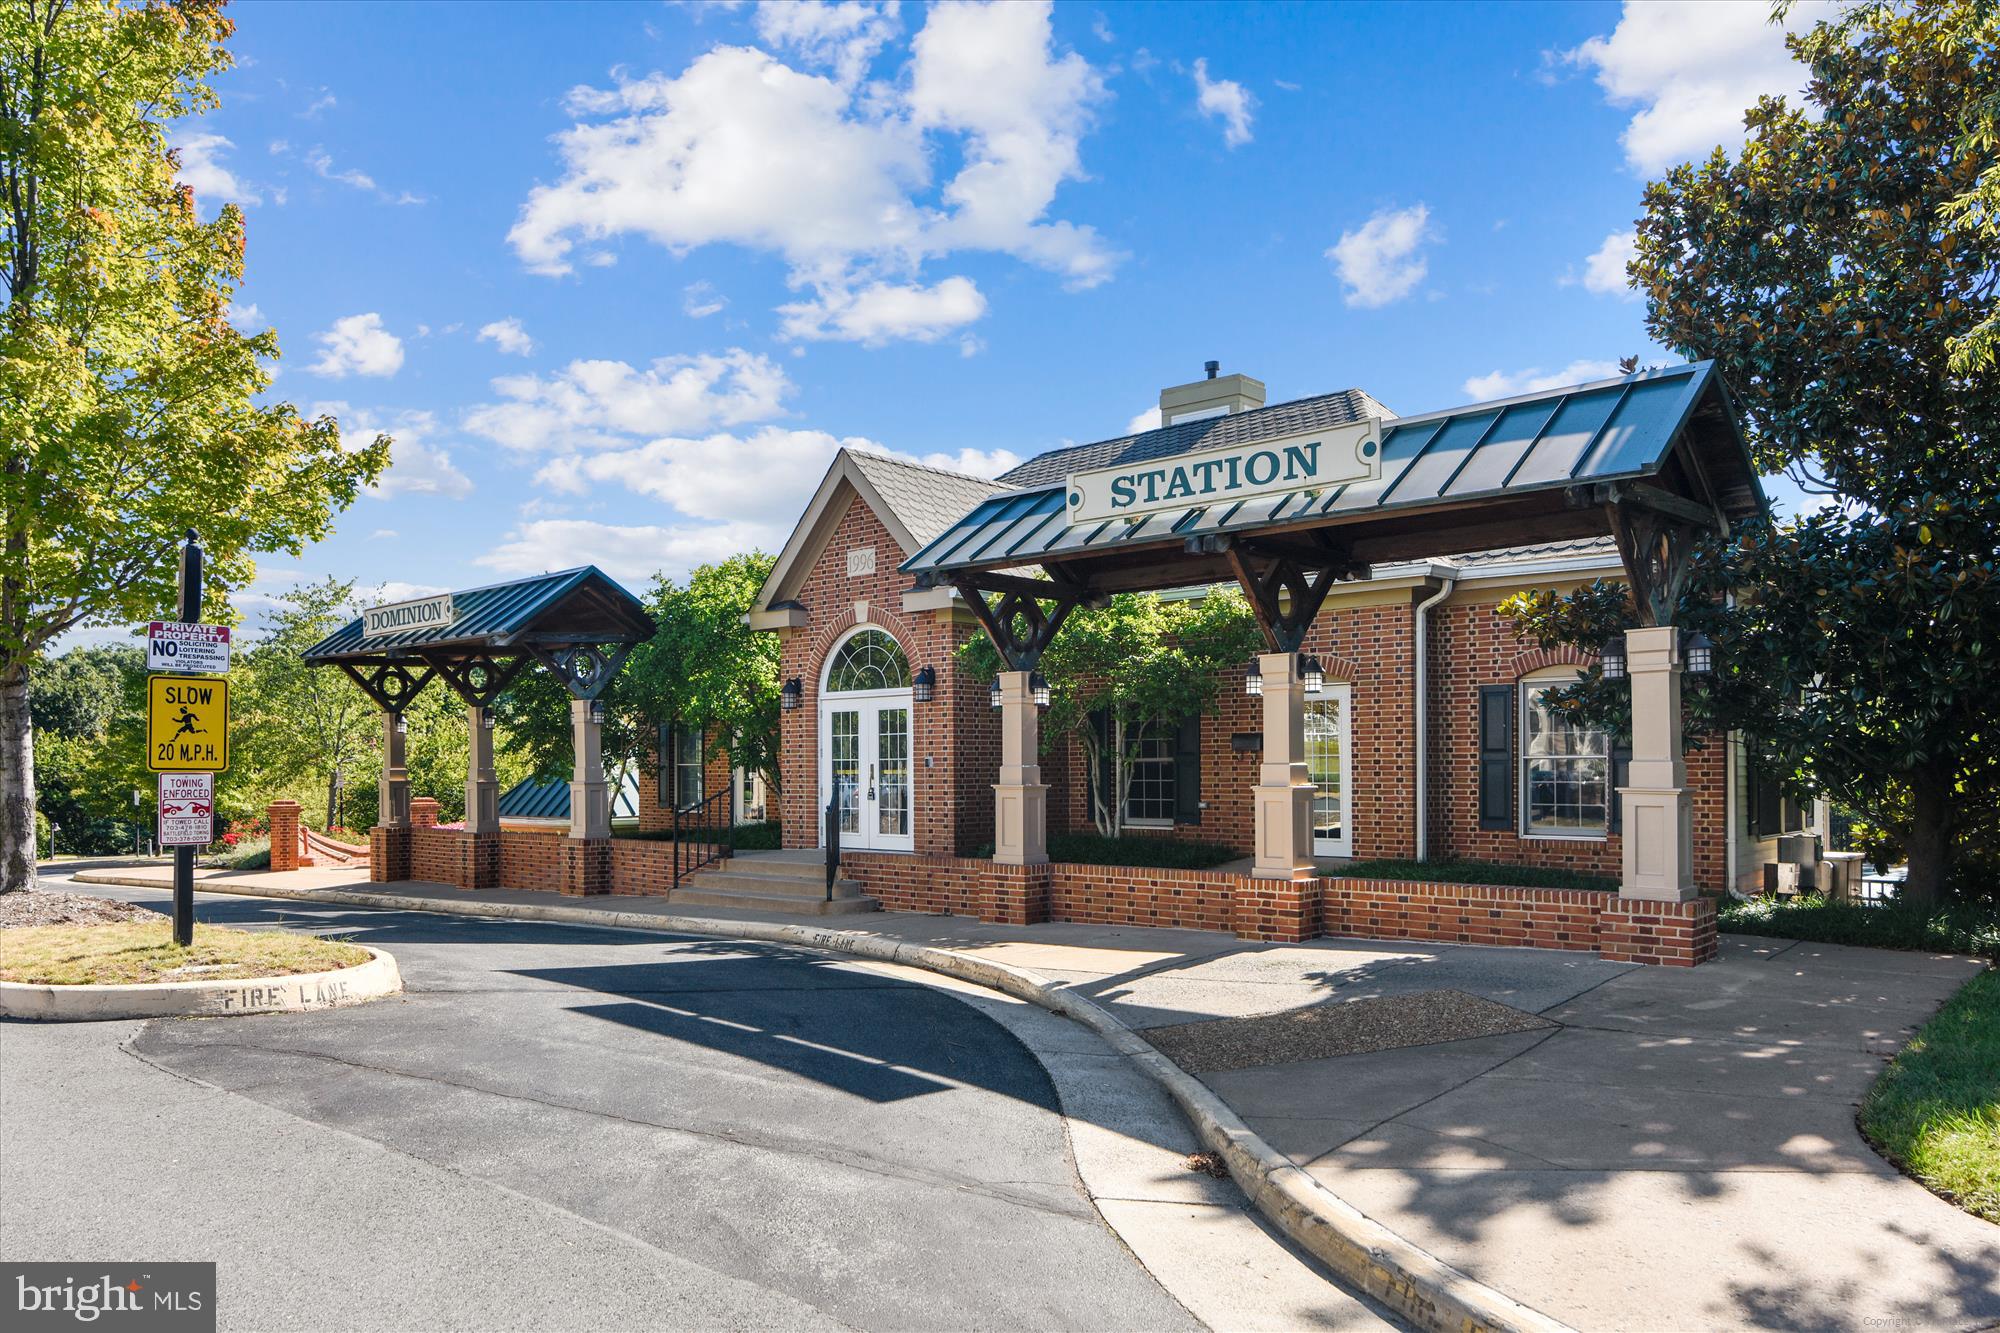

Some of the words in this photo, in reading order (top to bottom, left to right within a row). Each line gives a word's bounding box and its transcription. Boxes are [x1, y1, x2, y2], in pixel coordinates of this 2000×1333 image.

[1110, 441, 1322, 508] STATION
[848, 551, 874, 574] 1996
[370, 601, 442, 631] DOMINION
[162, 622, 218, 635] PRIVATE
[154, 630, 224, 643] PROPERTY
[152, 640, 178, 657] NO
[178, 640, 218, 648] SOLICITING
[178, 647, 216, 655] LOITERING
[178, 653, 226, 661] TRESPASSING
[165, 686, 213, 705] SLOW
[158, 743, 174, 761] 20
[180, 744, 218, 761] M.P.H.
[169, 779, 204, 788] TOWING
[163, 789, 210, 799] ENFORCED
[813, 933, 832, 945] FIRE
[223, 986, 281, 1010] FIRE
[299, 981, 348, 1004] LANE
